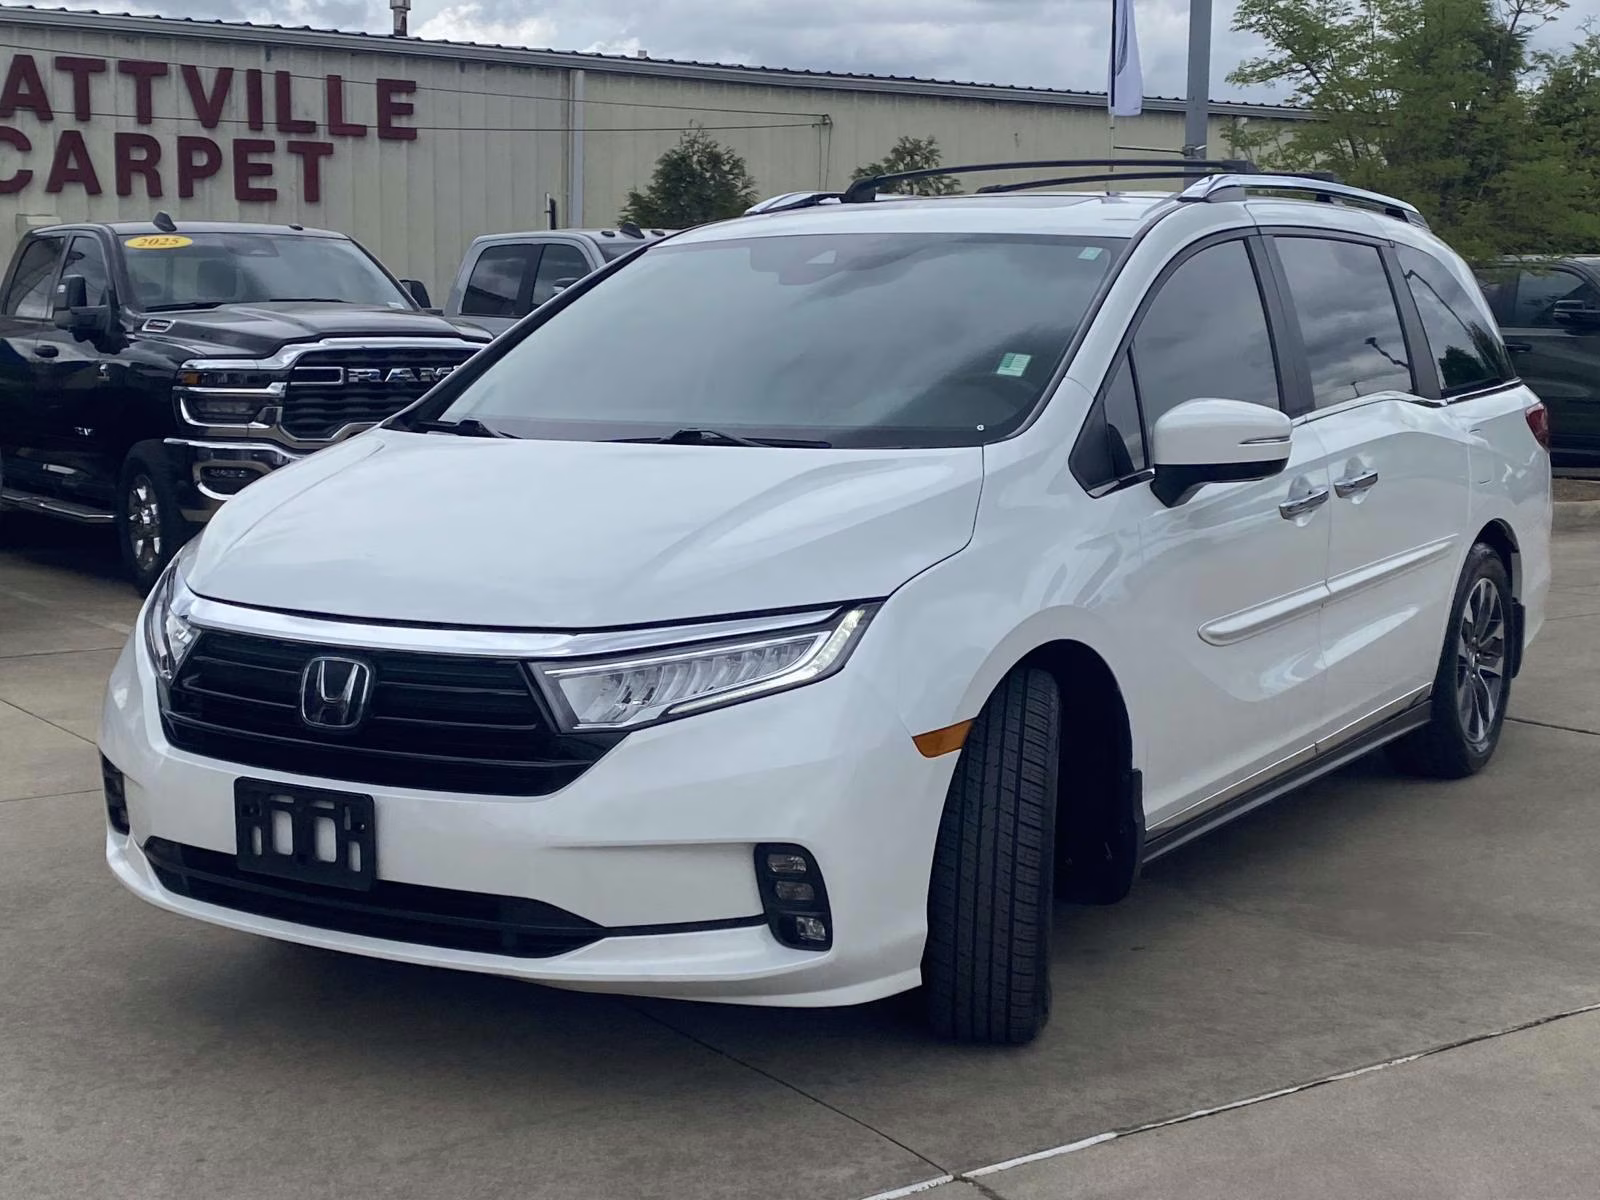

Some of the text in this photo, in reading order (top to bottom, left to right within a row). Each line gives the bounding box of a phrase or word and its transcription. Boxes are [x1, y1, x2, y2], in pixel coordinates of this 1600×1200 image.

[0, 54, 418, 141] ATTVILLE
[0, 126, 334, 203] CARPET
[135, 237, 179, 247] 2025
[347, 367, 453, 382] RAM
